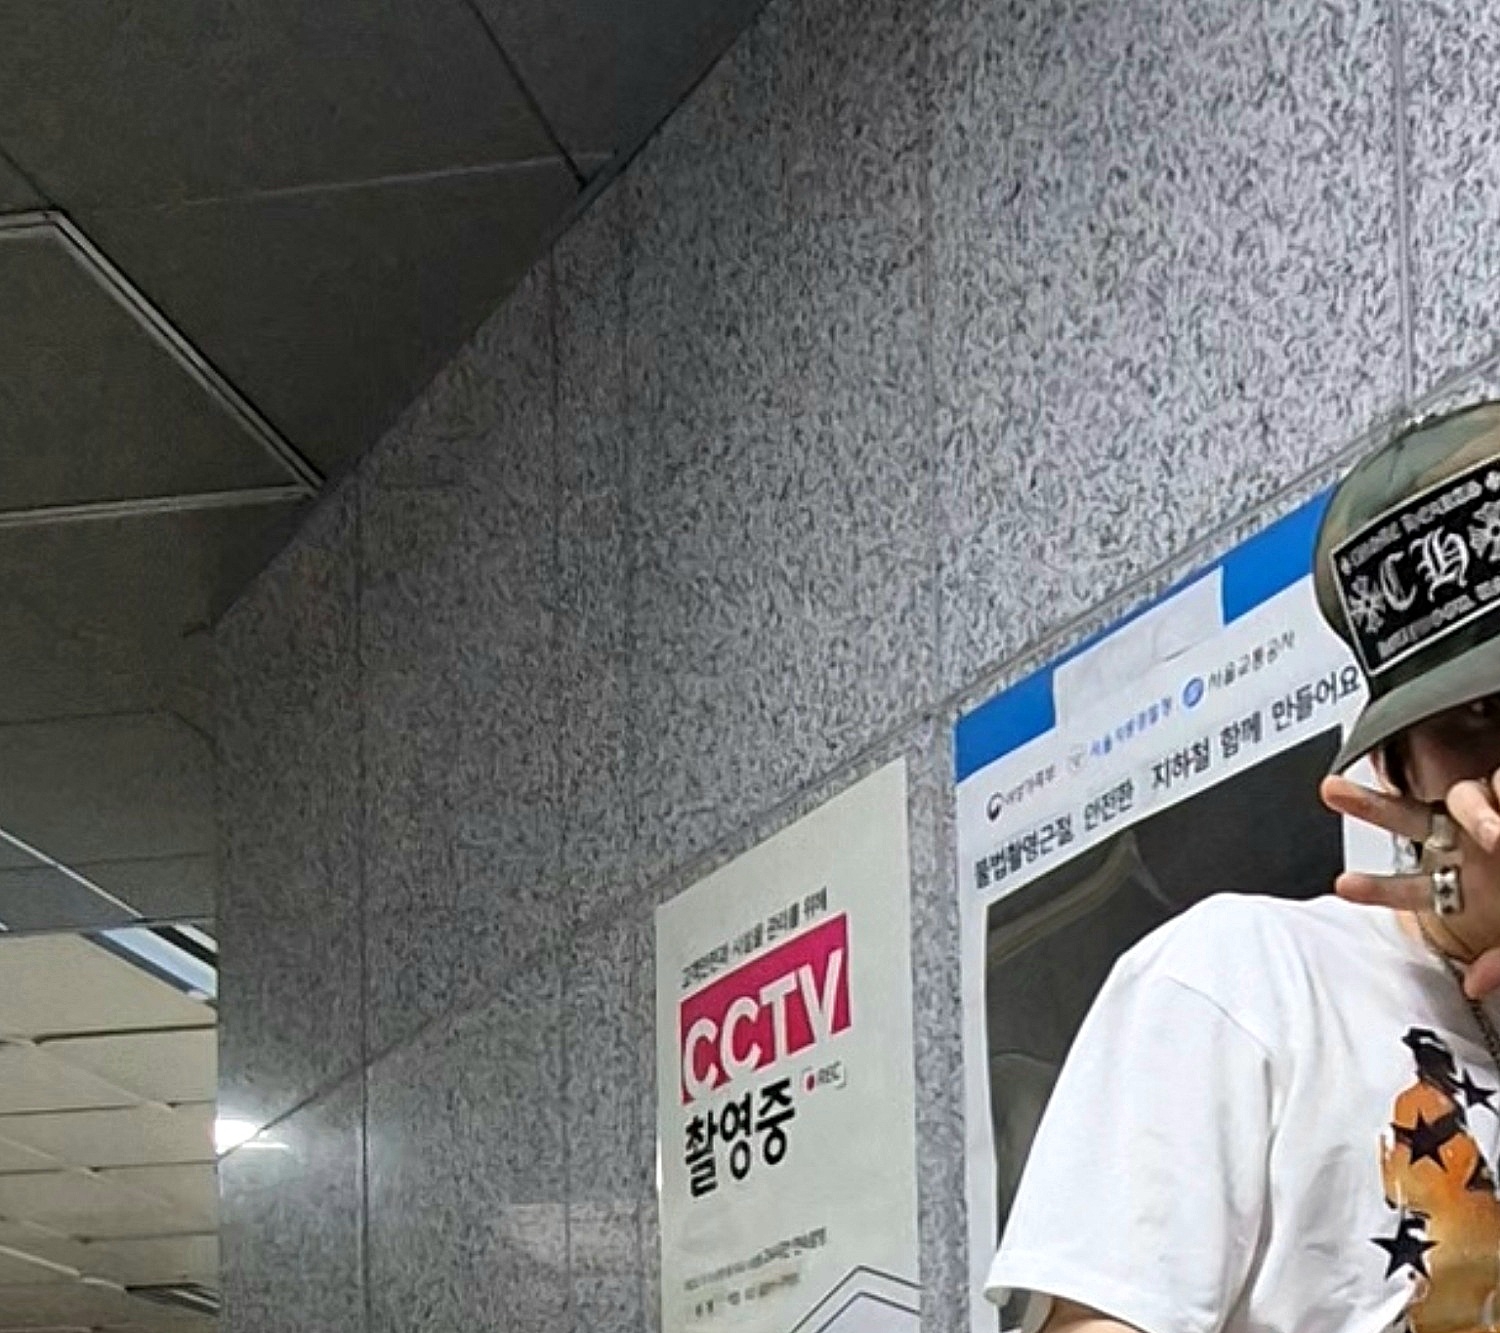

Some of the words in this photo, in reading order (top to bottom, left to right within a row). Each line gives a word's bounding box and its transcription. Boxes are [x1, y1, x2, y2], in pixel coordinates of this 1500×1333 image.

[1084, 777, 1134, 831] 안전한
[1151, 736, 1210, 789] 지하철
[1220, 710, 1262, 759] 함께
[1272, 664, 1360, 731] 만들어요
[684, 947, 844, 1095] CCTV
[685, 1077, 796, 1198] 촬영중
